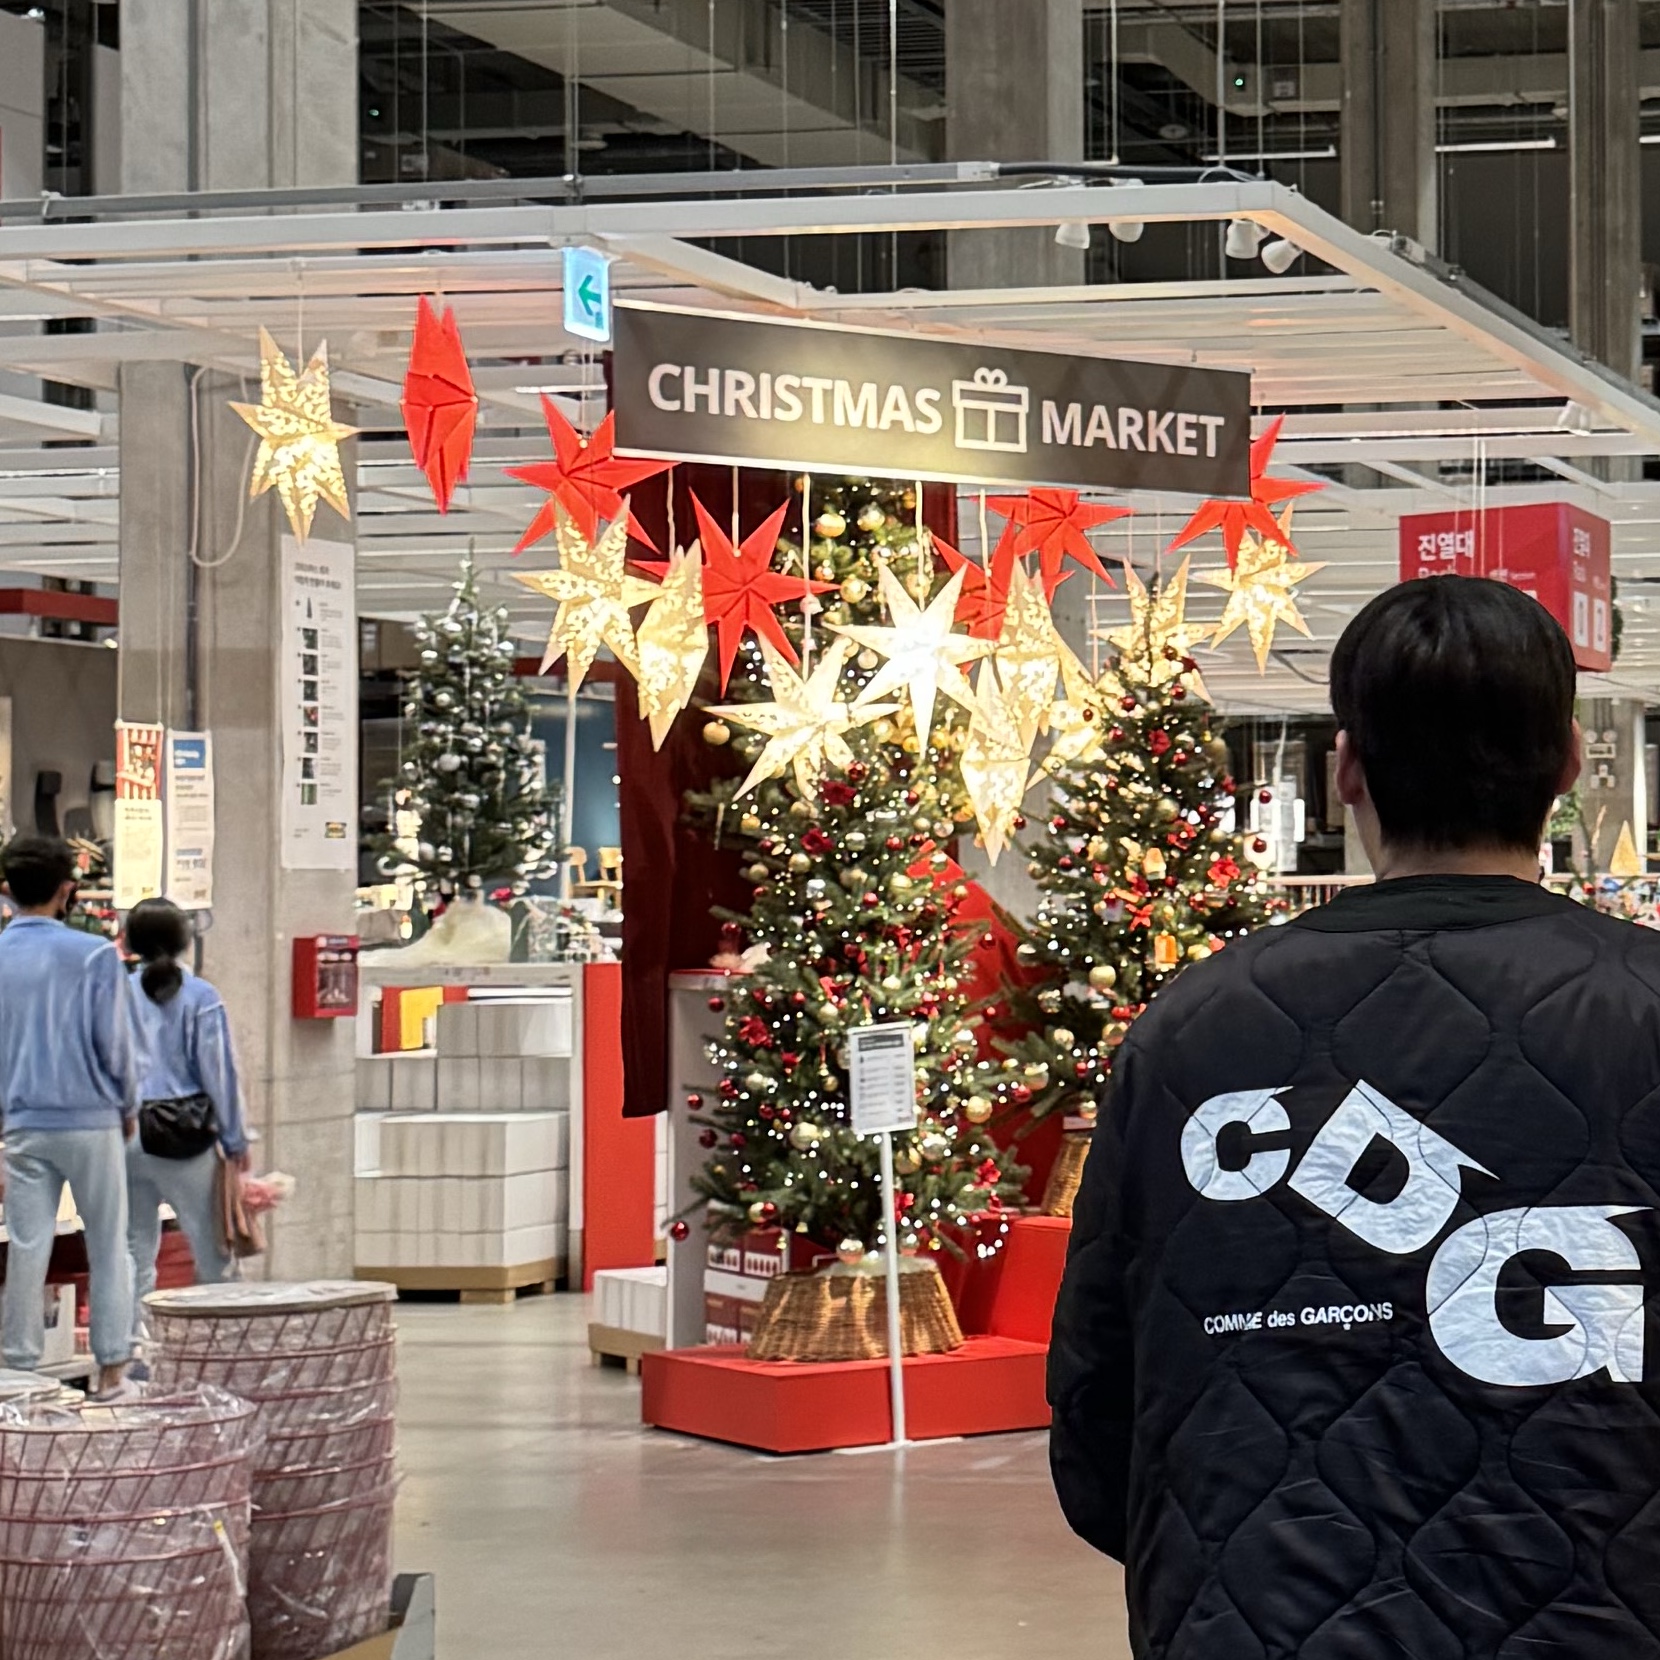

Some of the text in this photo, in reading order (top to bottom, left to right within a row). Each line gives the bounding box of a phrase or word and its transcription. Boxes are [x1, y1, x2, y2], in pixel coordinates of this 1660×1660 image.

[647, 363, 1225, 458] CHRISTMAS MARKET
[1418, 529, 1475, 561] 진열대
[1181, 1079, 1655, 1386] CDG
[1203, 1302, 1394, 1335] COMME des GARÇONS
